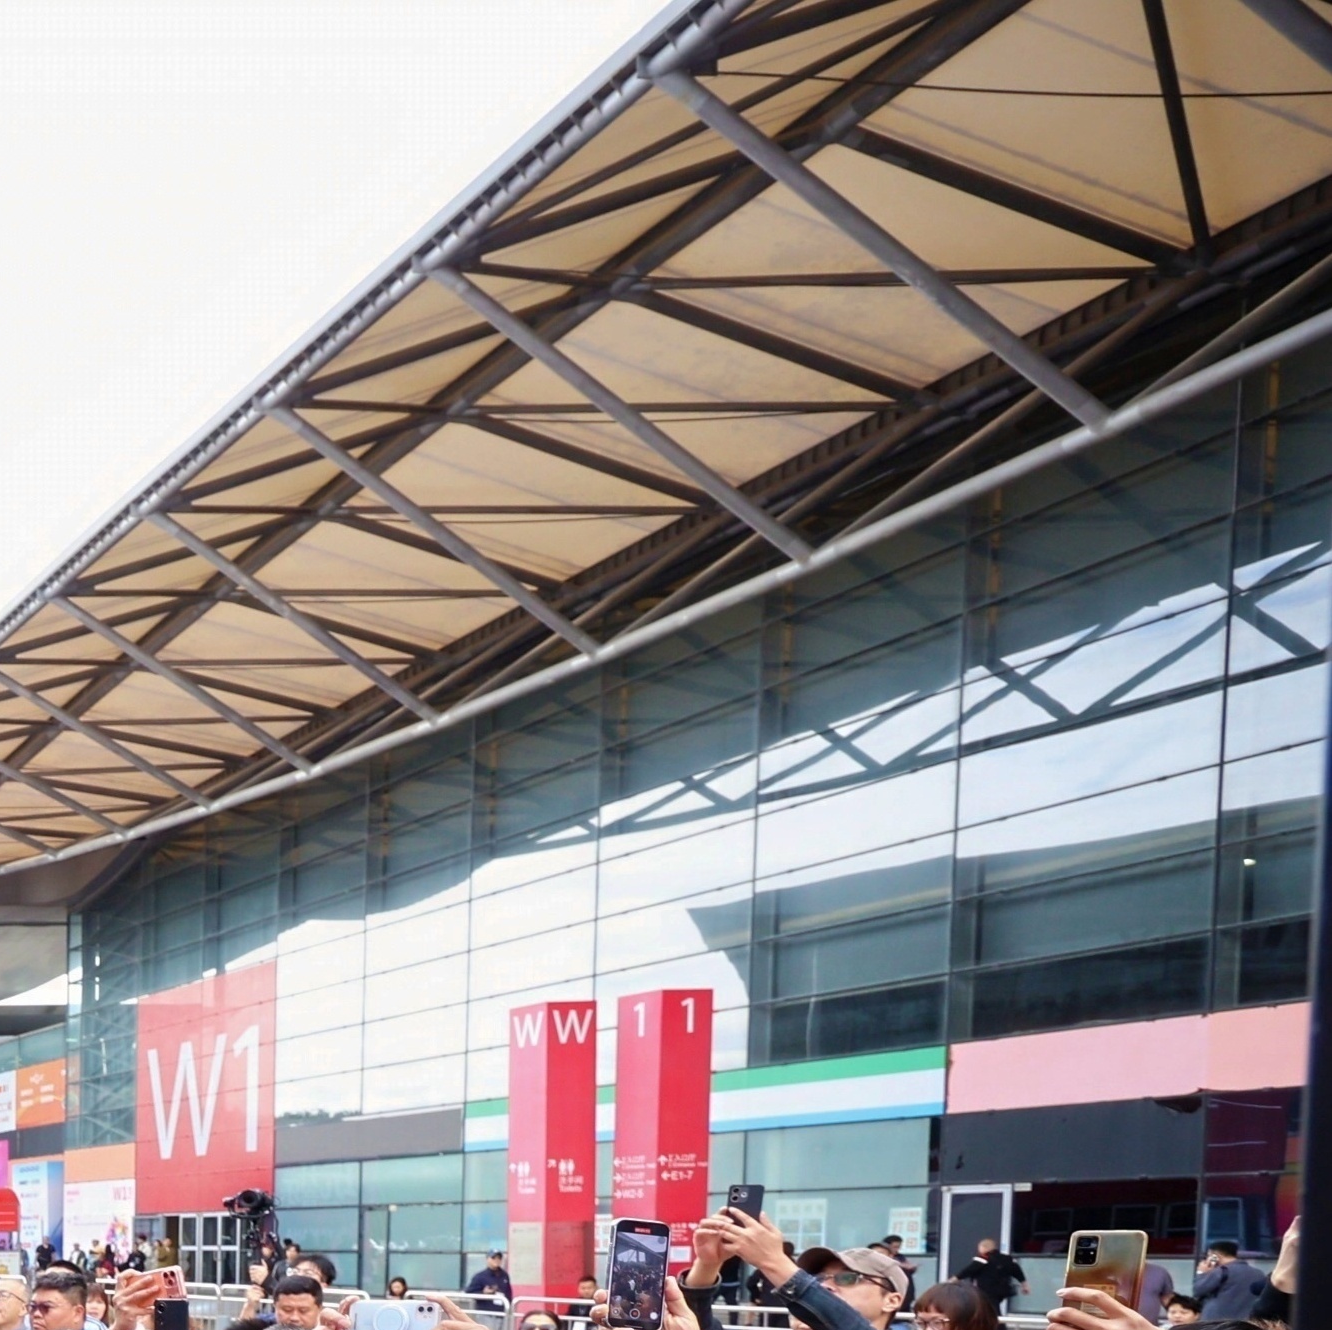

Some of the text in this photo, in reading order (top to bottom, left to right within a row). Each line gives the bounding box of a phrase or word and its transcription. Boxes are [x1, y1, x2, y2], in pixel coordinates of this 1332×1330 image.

[513, 1011, 542, 1048] W
[552, 1007, 593, 1045] W
[634, 1001, 646, 1037] 1
[680, 996, 694, 1034] 1
[147, 1024, 260, 1160] W1
[672, 1171, 694, 1181] E1-7
